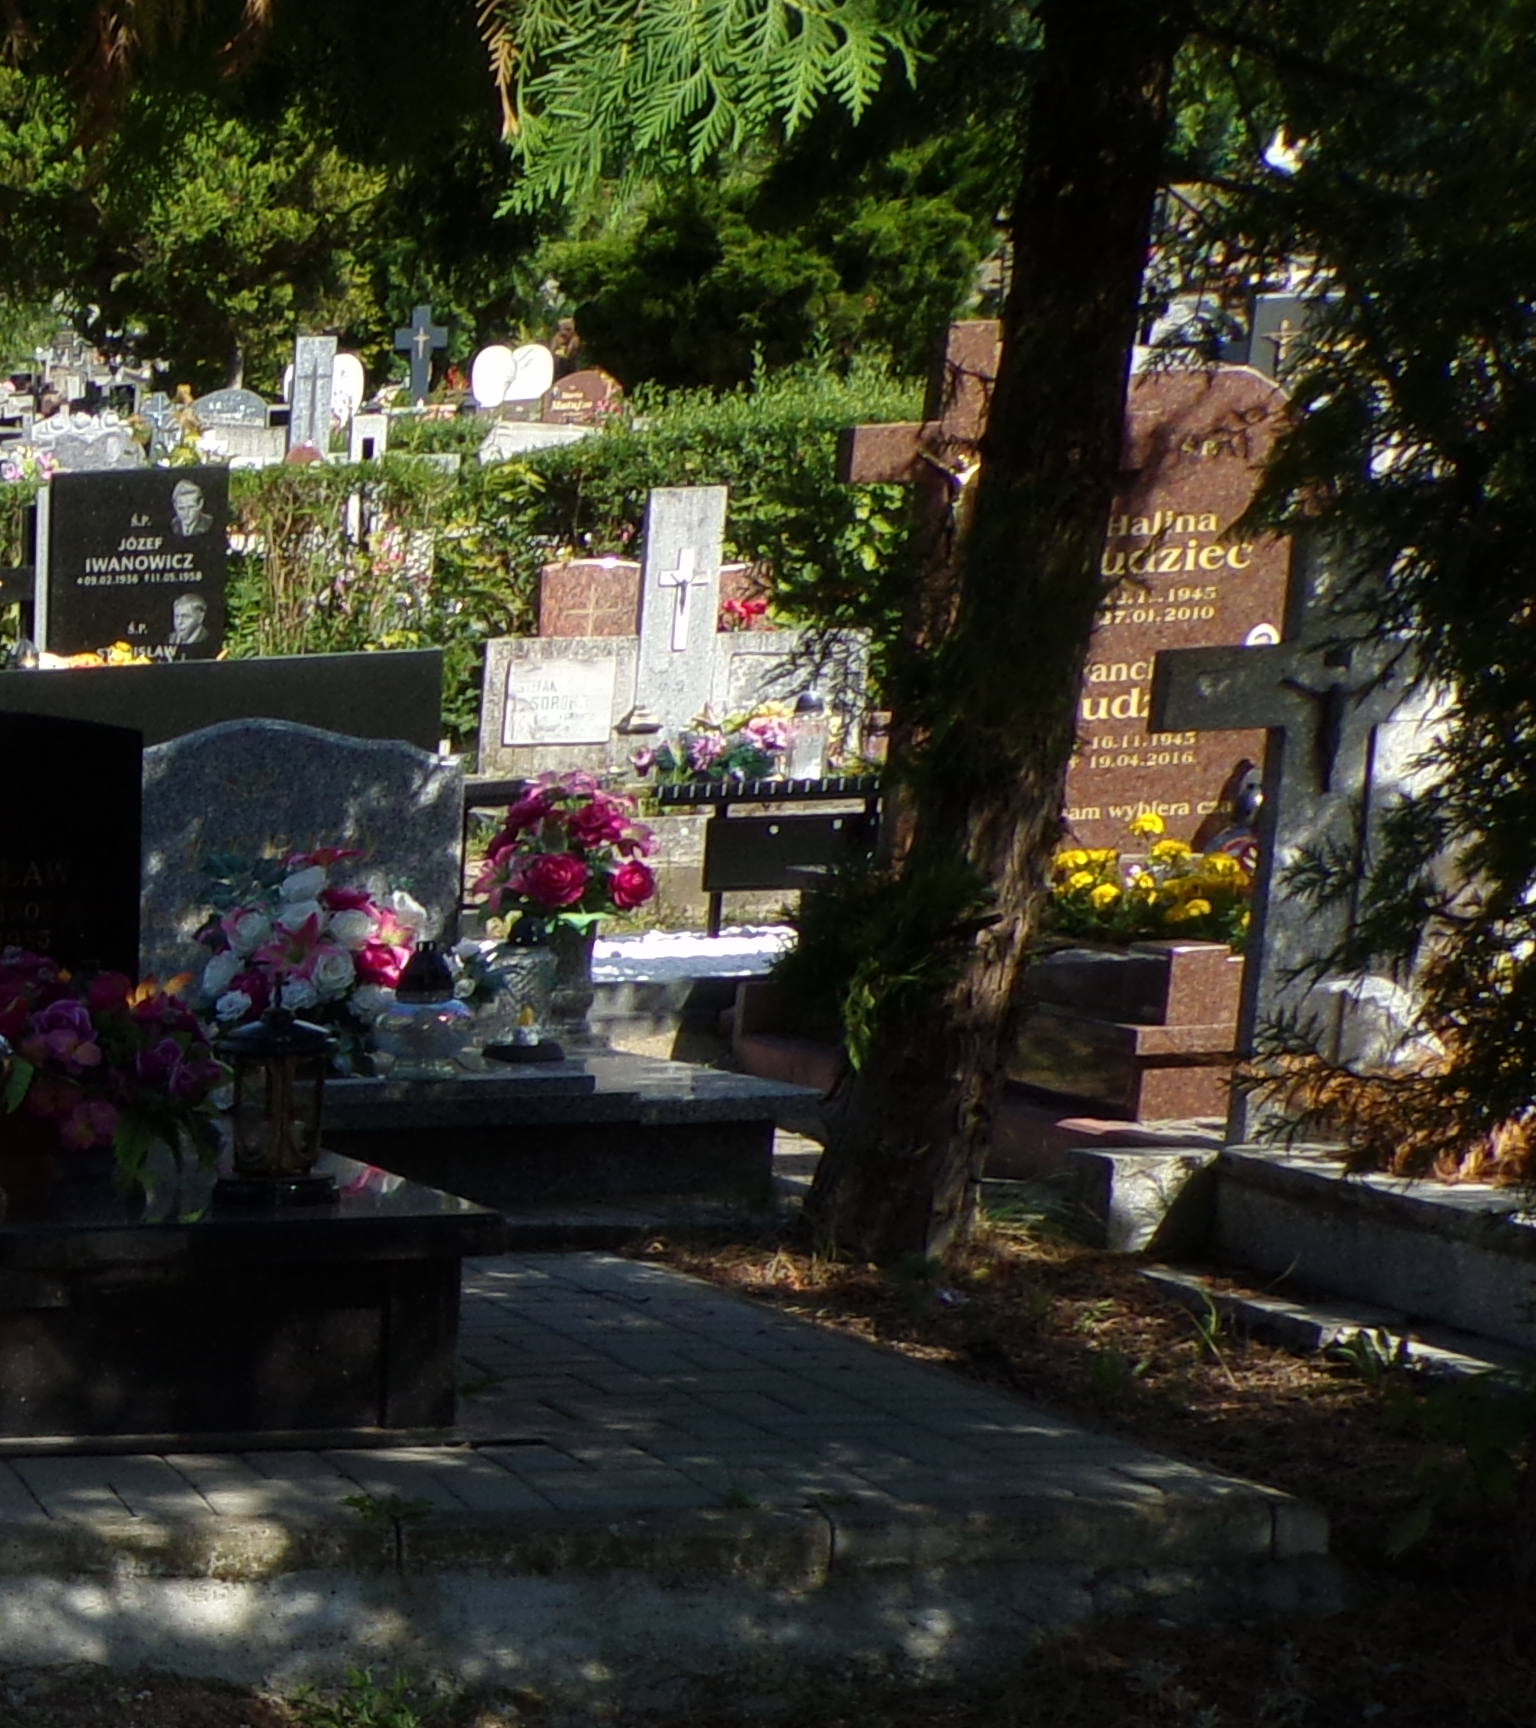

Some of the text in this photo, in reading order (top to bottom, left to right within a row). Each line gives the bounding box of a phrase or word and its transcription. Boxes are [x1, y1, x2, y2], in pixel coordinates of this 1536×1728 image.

[1106, 510, 1219, 538] Halina
[118, 536, 164, 551] JÓZEF
[85, 553, 195, 573] IWANOWICZ
